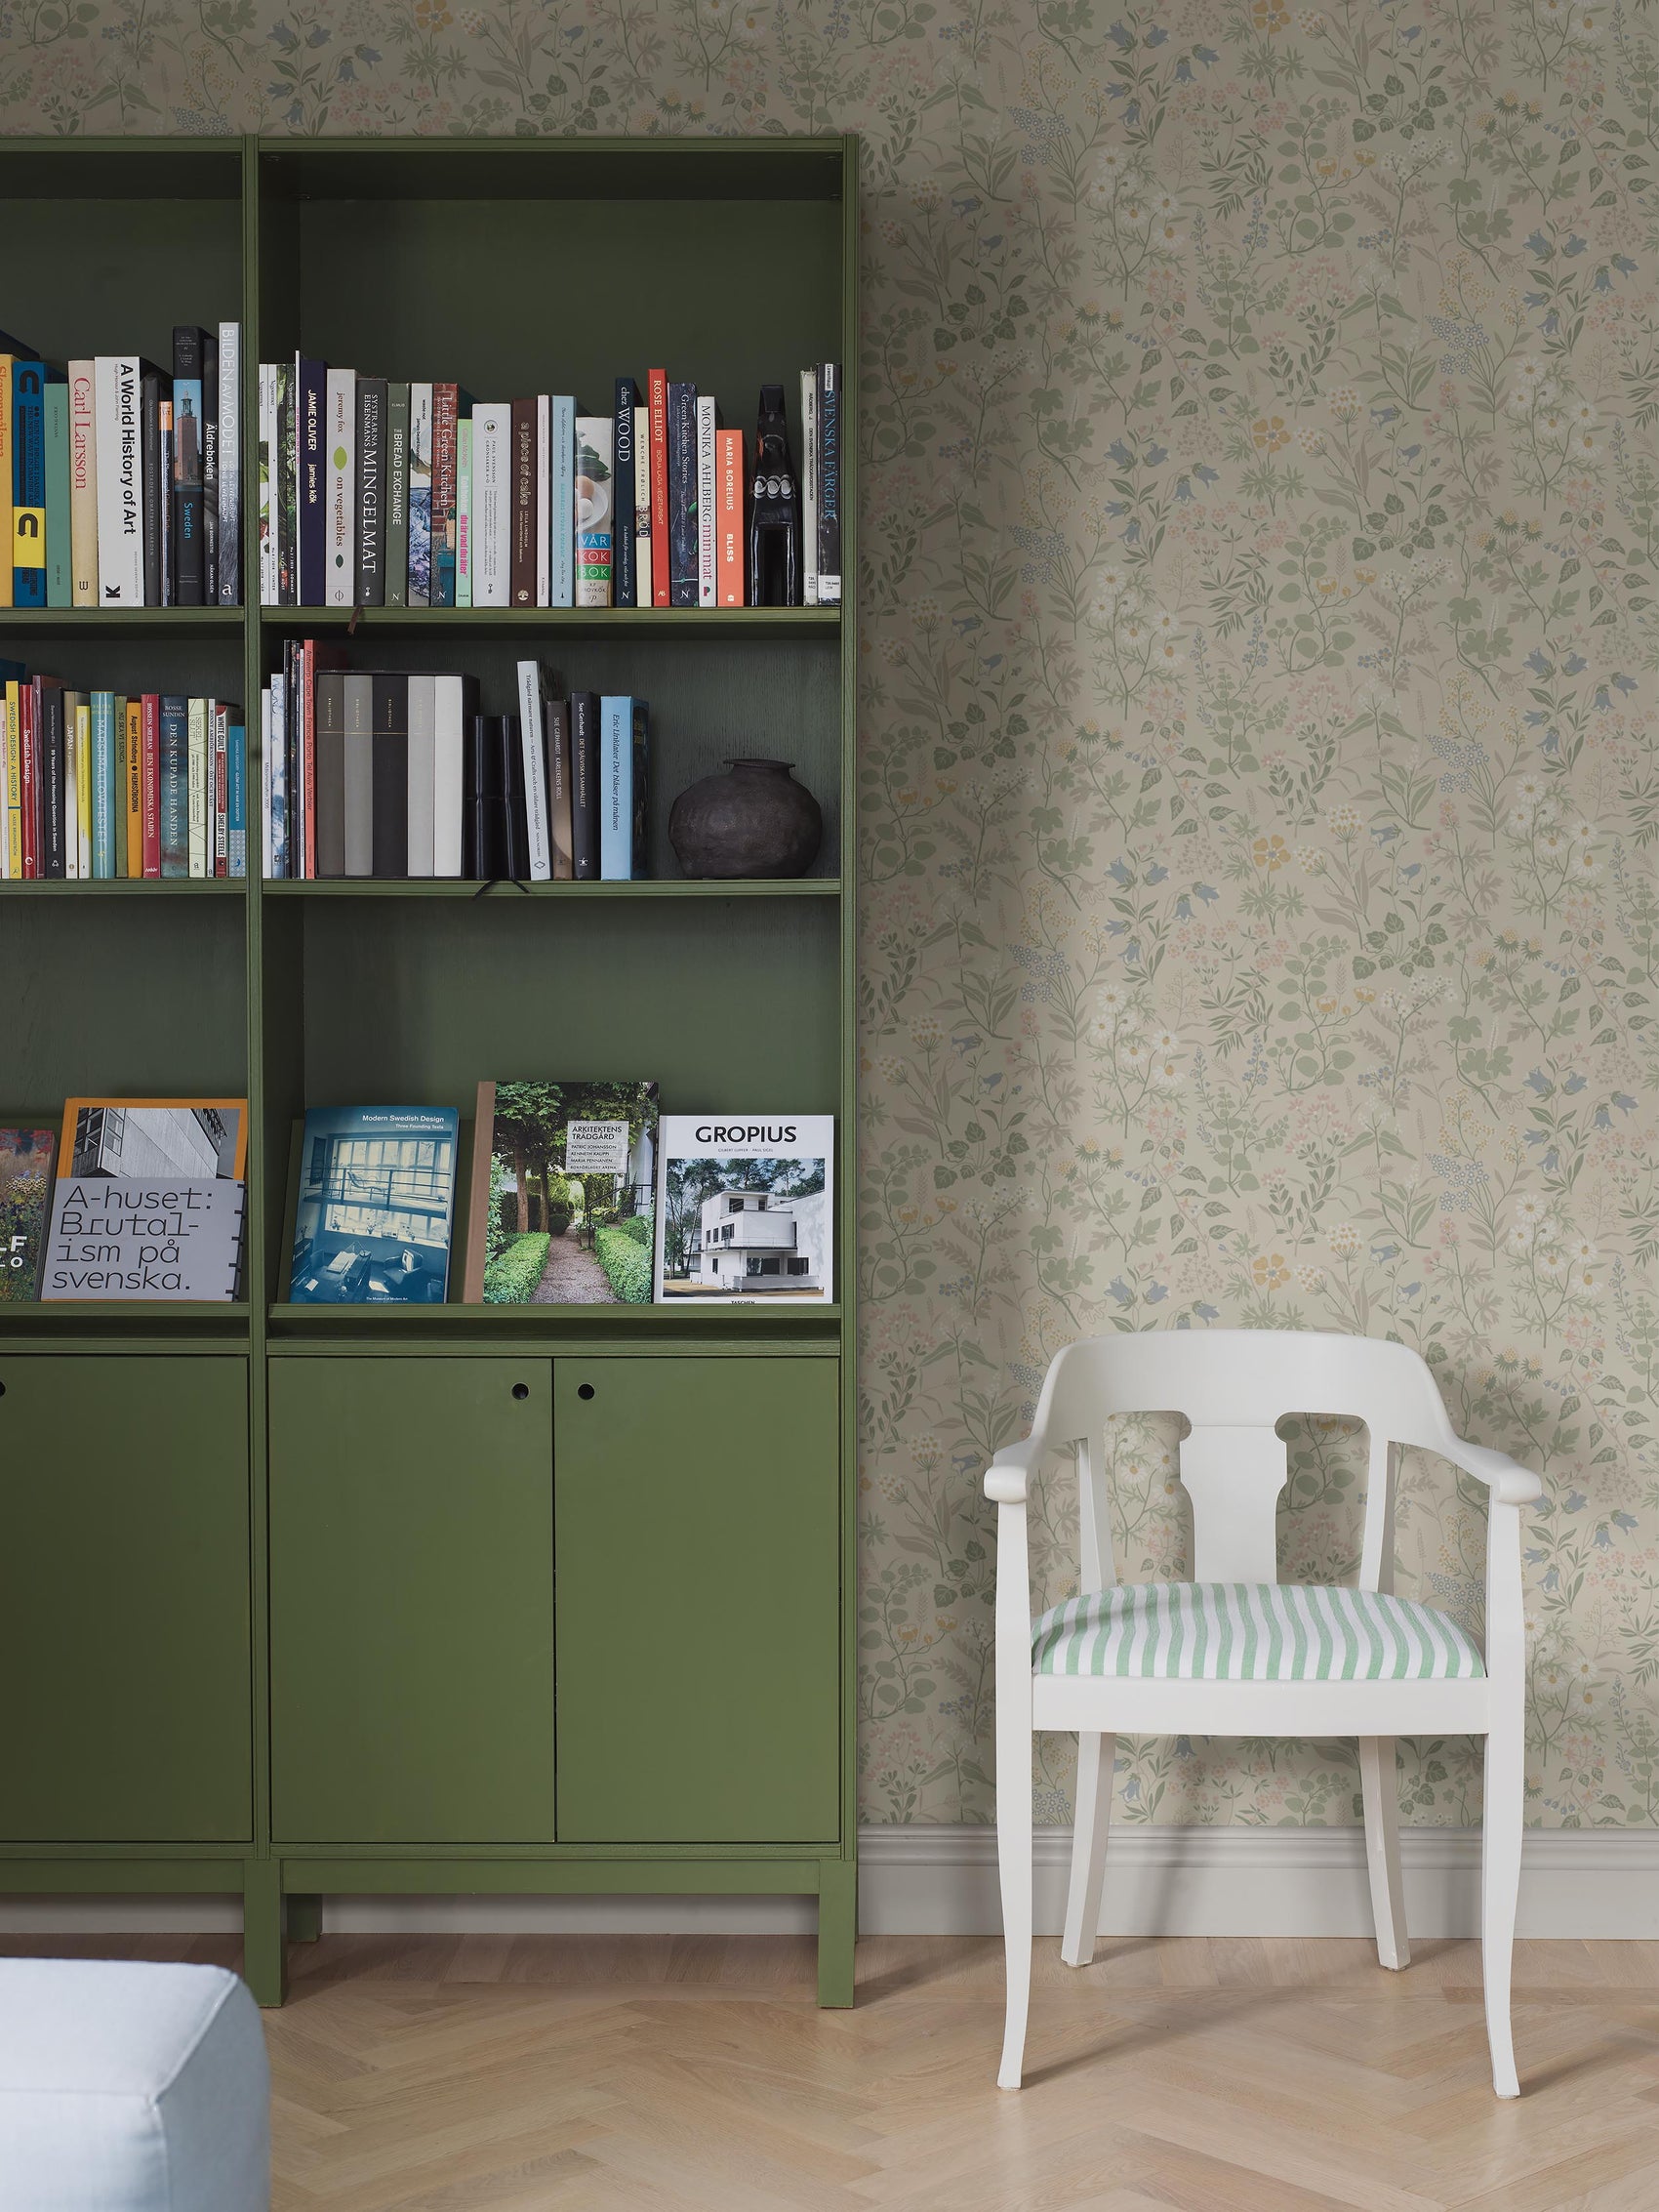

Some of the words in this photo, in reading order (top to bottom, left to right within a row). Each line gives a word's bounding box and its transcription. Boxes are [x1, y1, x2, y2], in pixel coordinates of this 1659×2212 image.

[120, 364, 134, 376] A
[222, 330, 235, 381] BILDEN
[73, 378, 91, 415] Carl
[121, 378, 135, 426] World
[222, 385, 232, 399] AV
[308, 389, 317, 417] JAMIE
[336, 392, 344, 418] jeremy
[621, 387, 629, 405] chez
[653, 380, 662, 405] ROSE
[440, 397, 453, 425] Little
[680, 394, 690, 420] Green
[222, 401, 235, 454] MODET
[308, 418, 317, 451] OLIVER
[337, 421, 345, 432] fox
[618, 407, 630, 462] WOOD
[654, 409, 663, 442] ELLIOT
[701, 405, 711, 458] MONIKA
[825, 390, 836, 457] SVENSKA
[205, 423, 218, 480] Äldreboken
[393, 433, 402, 468] BREAD
[440, 429, 452, 461] Green
[518, 431, 531, 462] piece
[680, 422, 690, 455] Kitchen
[725, 437, 734, 466] MARIA
[74, 421, 92, 489] Larsson
[120, 430, 136, 486] History
[307, 464, 316, 488] jamies
[337, 477, 344, 489] on
[520, 464, 531, 476] of
[681, 457, 691, 484] Stories
[123, 490, 137, 507] of
[308, 490, 317, 504] kök
[393, 471, 402, 525] EXCHANGE
[440, 465, 452, 507] Kitchen
[520, 477, 531, 506] cake
[702, 463, 711, 522] AHLBERG
[825, 461, 838, 519] FÄRGER
[124, 509, 137, 534] Art
[183, 502, 193, 539] Sweden
[335, 492, 345, 547] vegetables
[362, 449, 377, 573] MINGELMAT
[638, 506, 650, 537] BRÖD
[581, 534, 607, 546] VÅR
[703, 524, 715, 553] min
[581, 552, 607, 561] KOK
[703, 554, 713, 580] mat
[580, 567, 608, 577] BOK
[130, 736, 139, 763] Strindberg
[612, 729, 621, 760] Linklater
[97, 719, 106, 843] MARSHMALLOWTESTET
[131, 773, 140, 813] HEMSÖBORNA
[579, 777, 587, 807] SAMHÄLLET
[612, 774, 621, 796] blåser
[611, 797, 620, 806] på
[695, 1126, 797, 1143] GROPIUS
[63, 1185, 212, 1209] A-huset:
[60, 1211, 199, 1236] Brutal-
[56, 1238, 121, 1262] ism
[138, 1239, 181, 1269] på
[52, 1266, 190, 1290] svenska.
